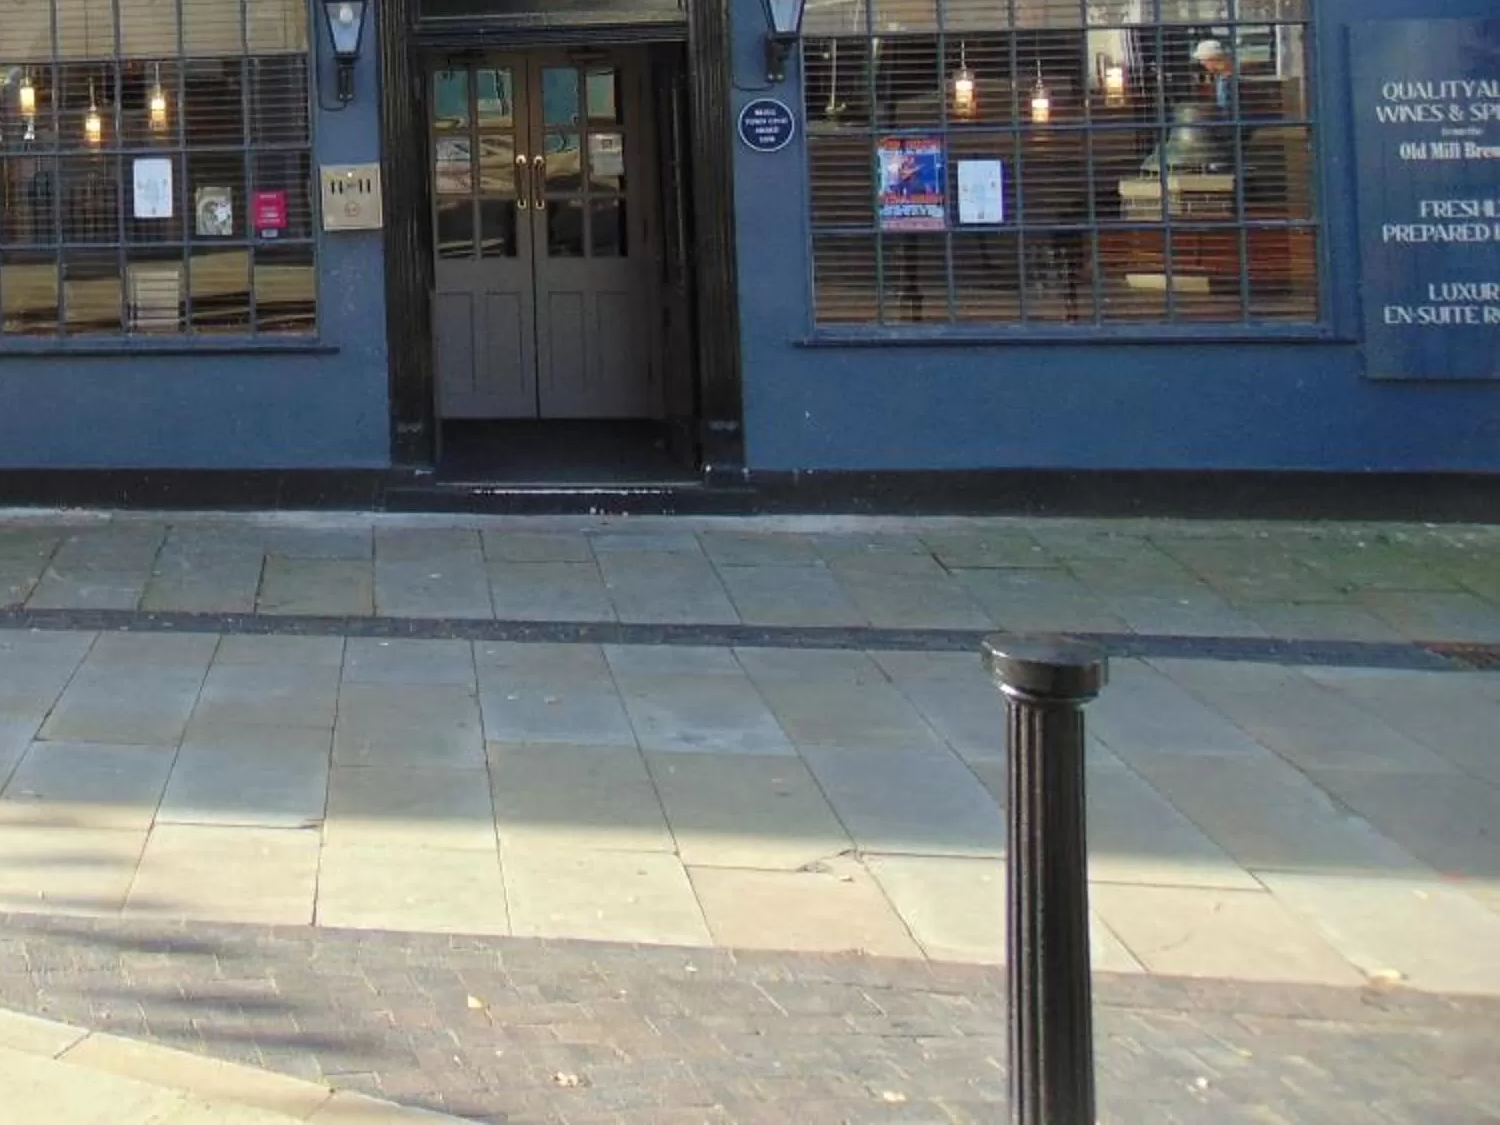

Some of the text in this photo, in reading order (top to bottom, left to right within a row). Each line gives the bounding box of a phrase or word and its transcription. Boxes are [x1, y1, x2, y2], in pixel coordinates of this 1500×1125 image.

[1382, 80, 1475, 102] QUALITY
[1376, 104, 1445, 123] WINES
[1449, 103, 1465, 123] &
[1399, 141, 1427, 160] Old
[1430, 140, 1461, 160] Mill
[1382, 222, 1488, 243] PREPARED
